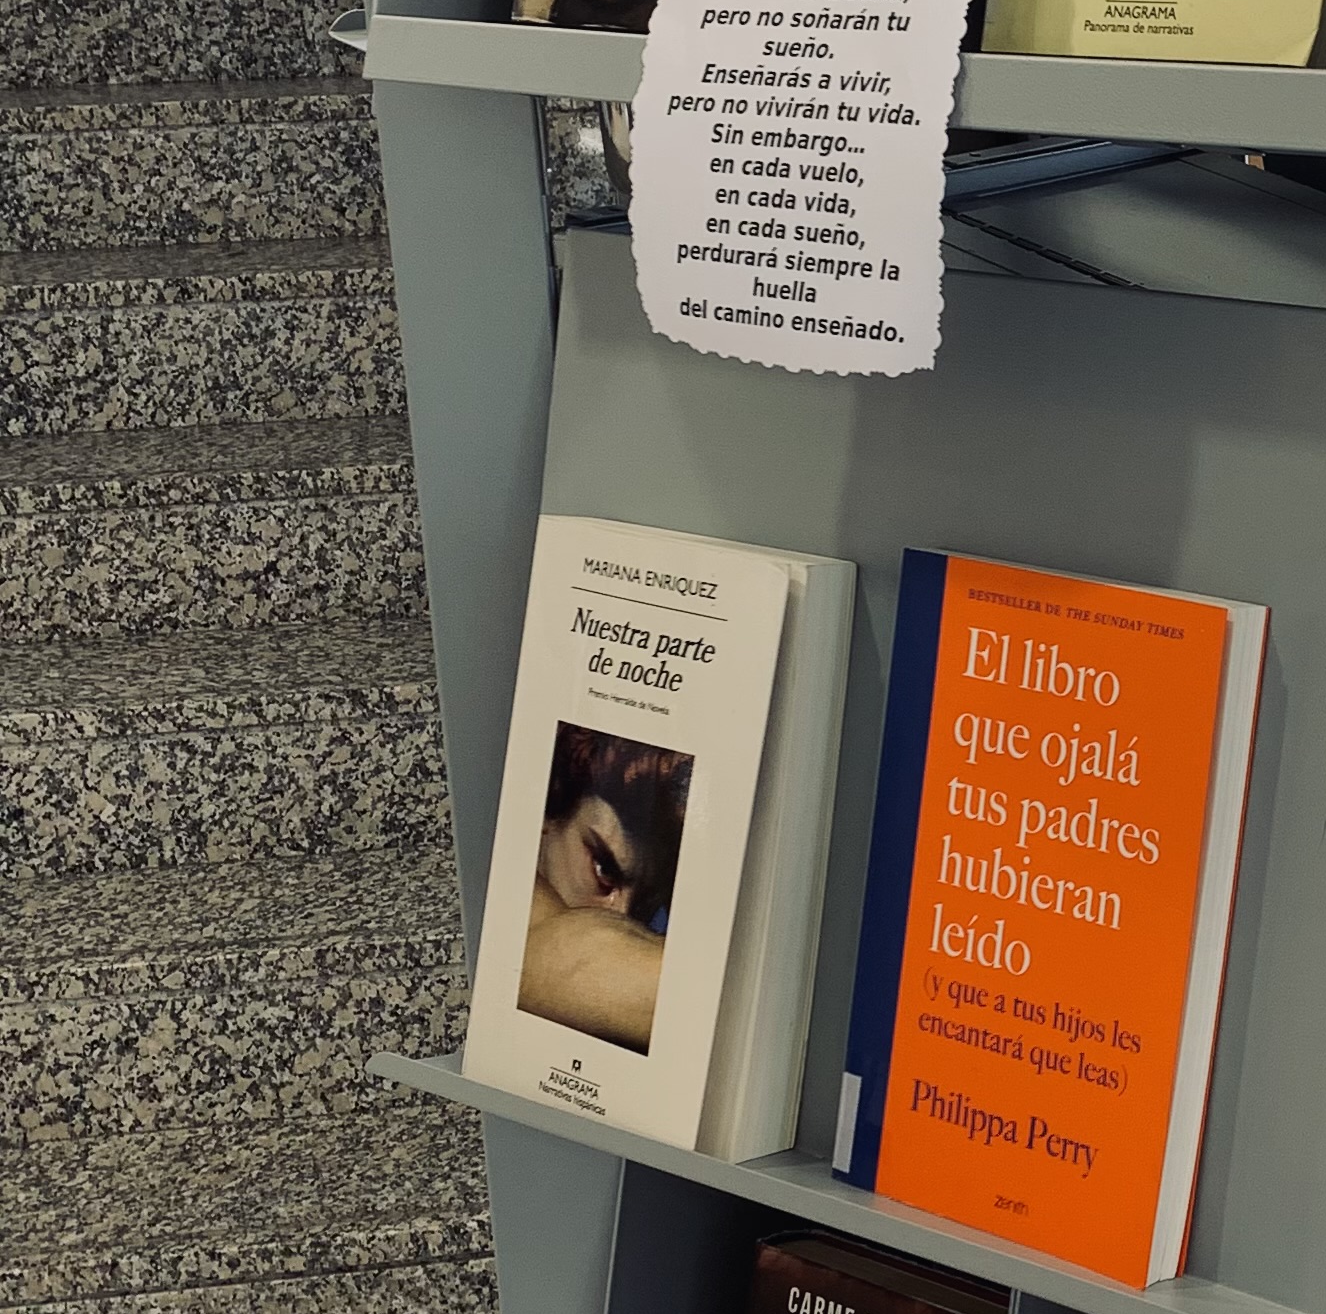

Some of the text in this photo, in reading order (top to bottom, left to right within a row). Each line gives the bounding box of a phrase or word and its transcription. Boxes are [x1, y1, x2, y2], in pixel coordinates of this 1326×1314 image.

[701, 7, 910, 32] pero no soñarán tu
[1084, 20, 1194, 35] Panorama de narrativas
[1104, 5, 1176, 20] ANAGRAMA
[763, 37, 834, 59] sueño.
[701, 63, 891, 96] Enseñarás a vivir,
[667, 93, 921, 126] pero no vivirán tu vida.
[712, 123, 744, 145] Sin
[709, 155, 864, 187] en cada vuelo,
[715, 186, 856, 217] en cada vida,
[706, 216, 865, 249] en cada sueño,
[677, 241, 900, 281] perdurará siempre la
[753, 277, 817, 302] huella
[680, 298, 905, 342] del camino enseñado.
[583, 558, 718, 599] MARIANA ENRIQUEZ
[571, 607, 715, 663] Nuestra parte
[1045, 603, 1061, 616] DE
[1066, 607, 1090, 620] THE
[1095, 612, 1144, 631] SUNDAY
[1147, 622, 1184, 639] TIMES
[589, 648, 682, 691] de noche
[963, 627, 1120, 706] El libro
[954, 712, 1141, 786] que ojalá
[948, 777, 1160, 864] tus padres
[938, 835, 1120, 929] hubieran
[929, 903, 1031, 976] leído
[548, 1072, 598, 1099] ANAGRAMA
[910, 1079, 1098, 1179] Philippa Perry
